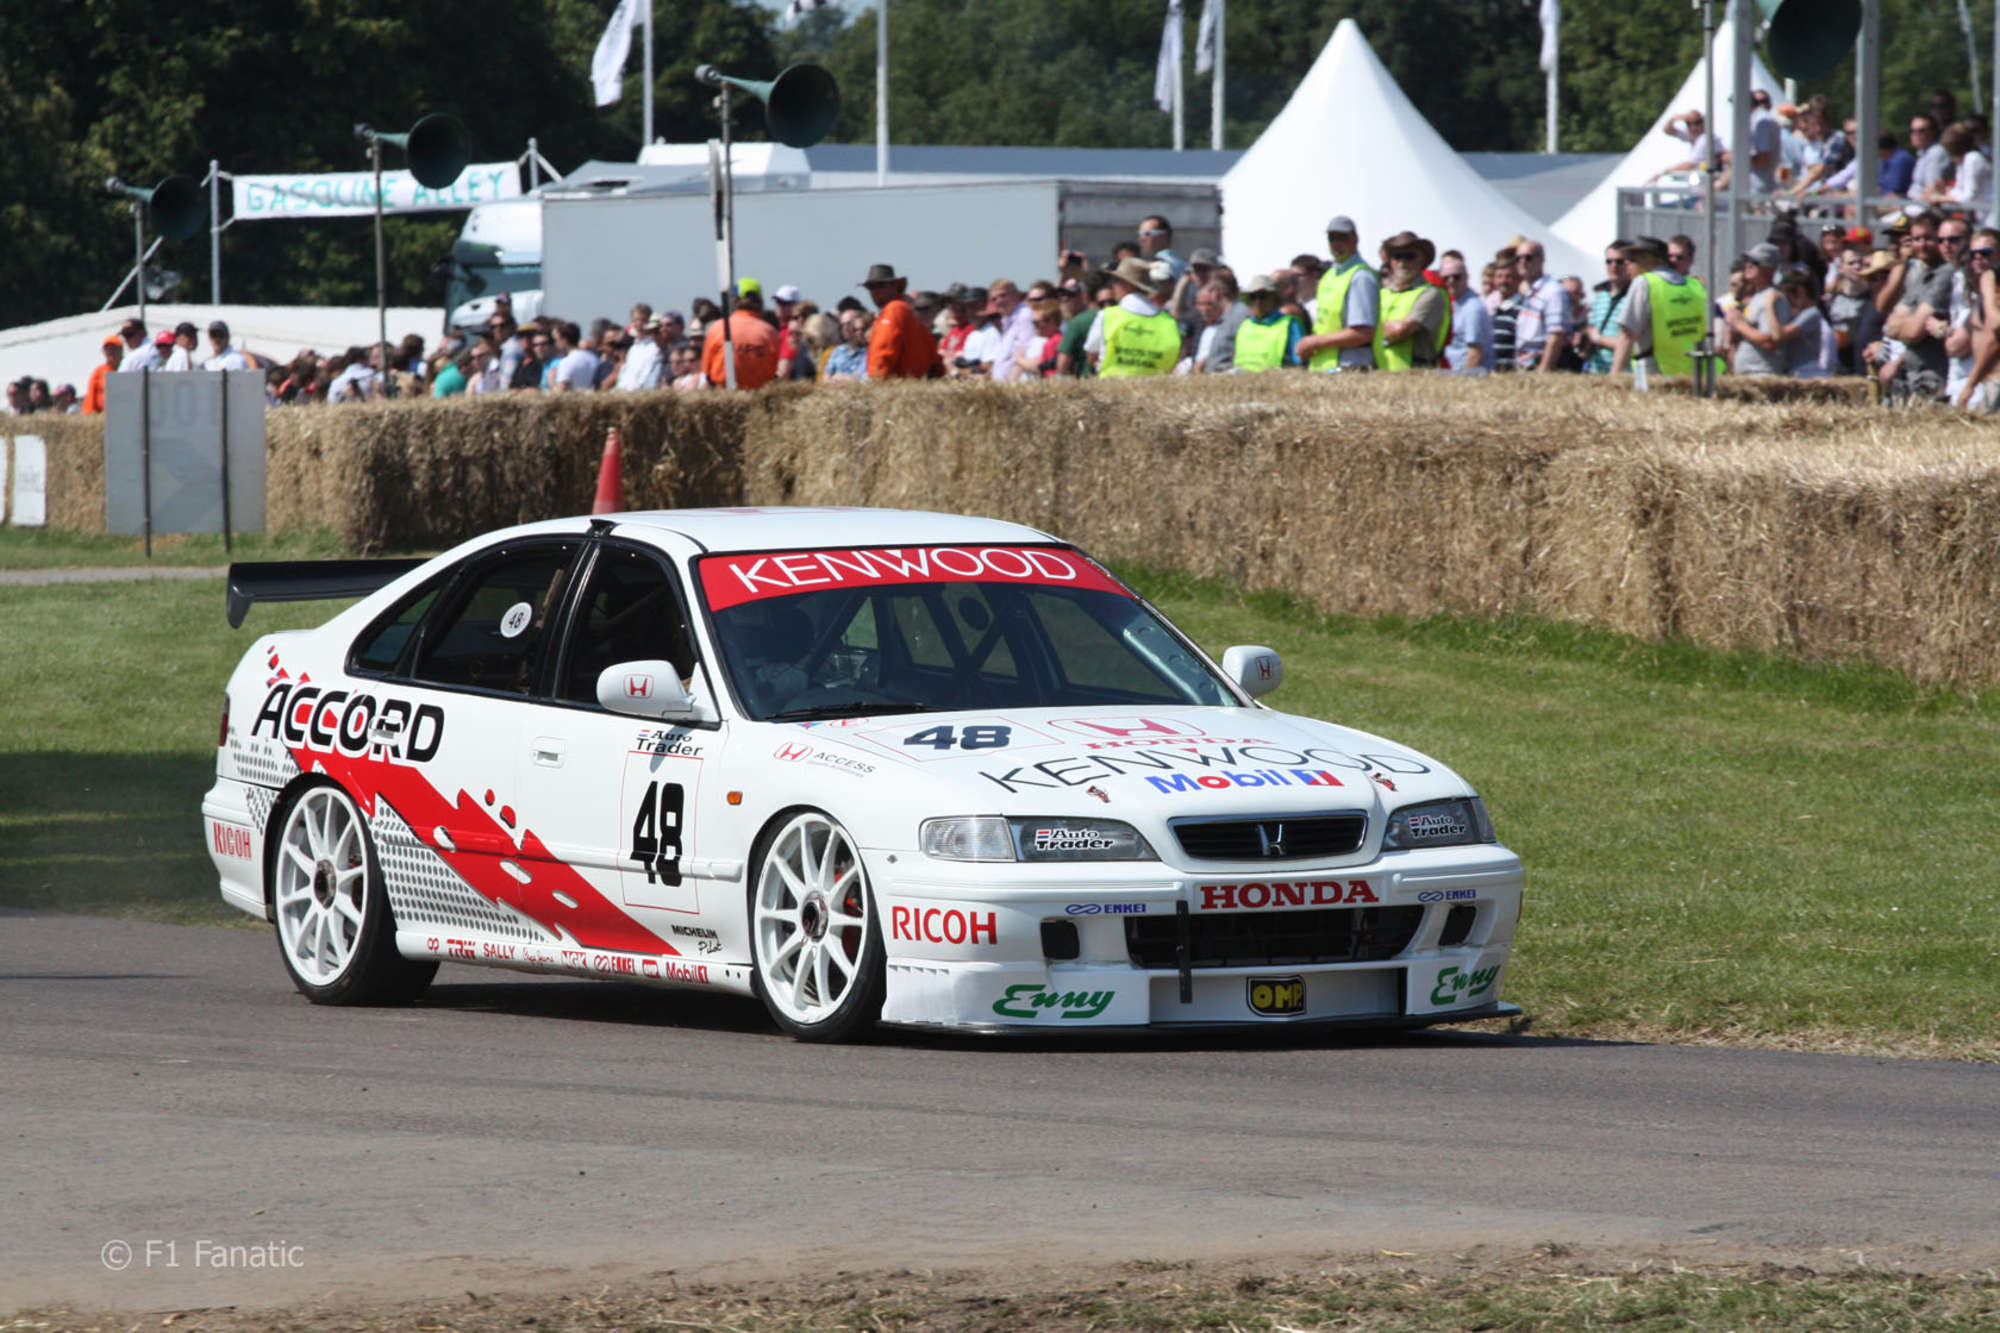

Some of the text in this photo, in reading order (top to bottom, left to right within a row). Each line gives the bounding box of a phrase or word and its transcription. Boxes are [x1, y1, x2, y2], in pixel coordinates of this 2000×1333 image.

[247, 170, 506, 211] GASOLINE ALLEY
[729, 548, 1077, 593] KENWOOD
[508, 611, 525, 629] 48
[251, 683, 444, 763] ACCORD
[651, 729, 693, 743] Auto
[902, 725, 1011, 750] 48
[1082, 737, 1277, 750] HONDA
[637, 737, 704, 757] Trader
[813, 752, 876, 773] ACCESS
[979, 745, 1431, 793] KENWOOD
[1145, 769, 1293, 794] Mobil
[1411, 825, 1465, 837] Trader
[1420, 815, 1454, 827] Auto
[213, 822, 252, 857] RICOH
[630, 781, 684, 887] 48
[1036, 838, 1115, 850] Trader
[1052, 828, 1100, 840] Auto
[1201, 880, 1379, 909] HONDA
[1445, 889, 1477, 899] ENKEI
[1104, 903, 1147, 914] ENKEI
[671, 925, 717, 939] MICHELIN
[892, 906, 998, 945] RICOH
[483, 943, 516, 959] SALLY
[665, 961, 698, 982] Mobil
[1253, 983, 1302, 1008] OMP
[1430, 965, 1500, 1006] Enny
[992, 984, 1115, 1018] Enny
